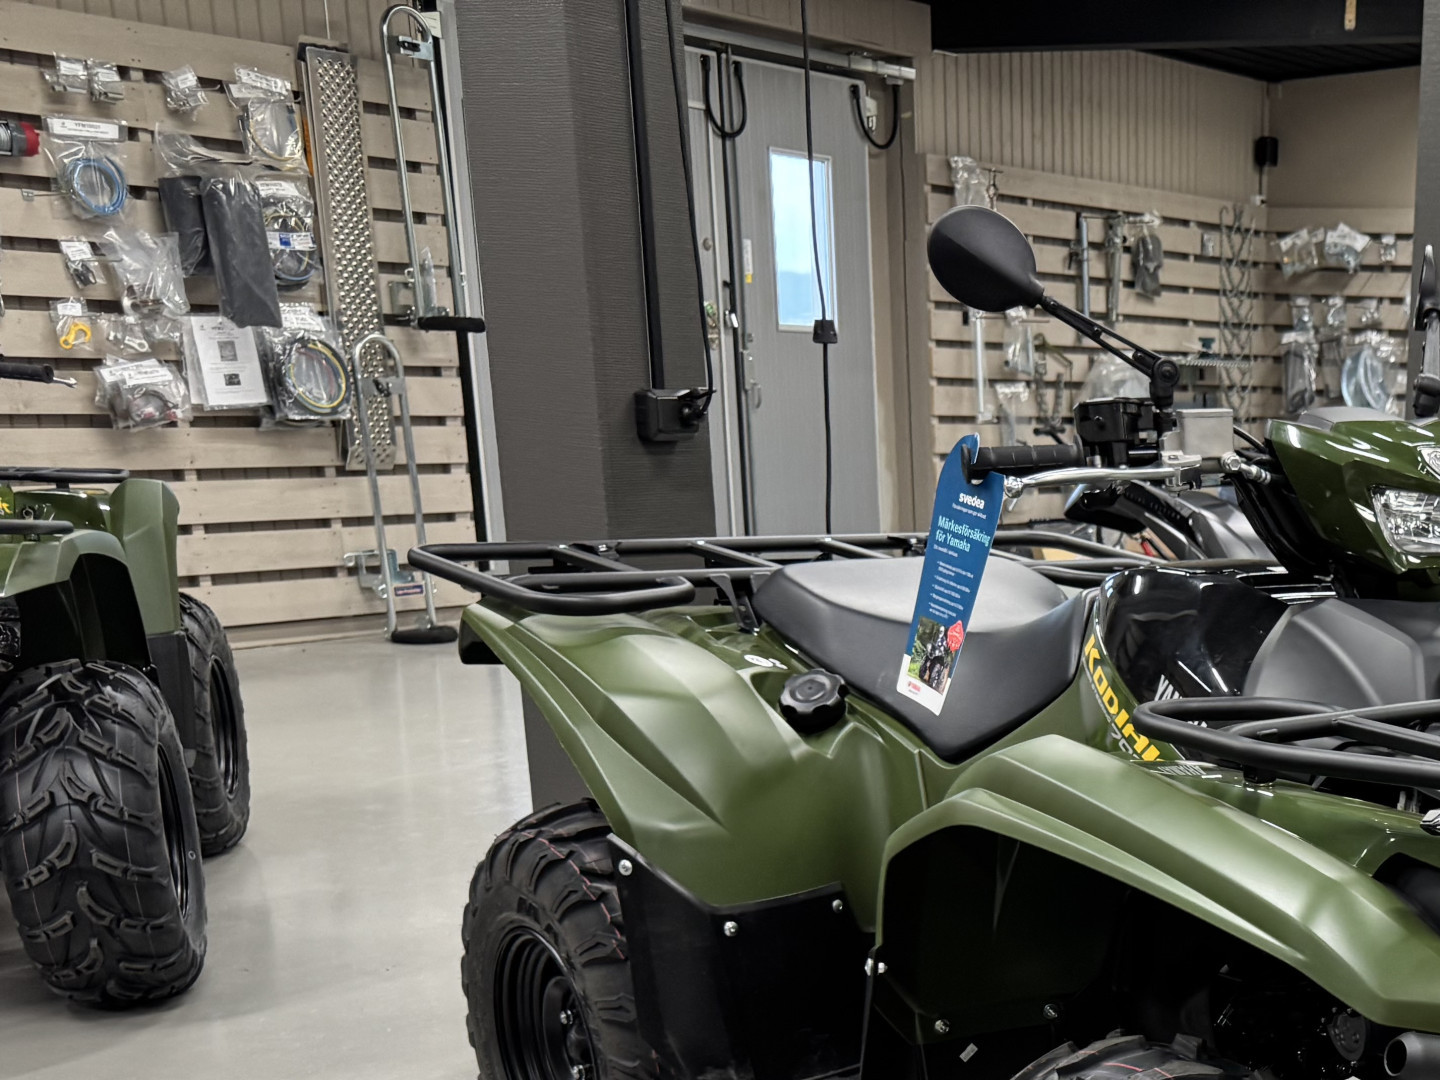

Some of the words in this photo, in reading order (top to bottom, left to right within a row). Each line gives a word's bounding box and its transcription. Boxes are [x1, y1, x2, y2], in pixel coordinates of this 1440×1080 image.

[959, 493, 985, 509] svedea
[935, 530, 946, 543] för
[946, 532, 971, 553] Yamaha
[938, 515, 991, 547] Märkesförsäkring
[1110, 721, 1141, 759] 70
